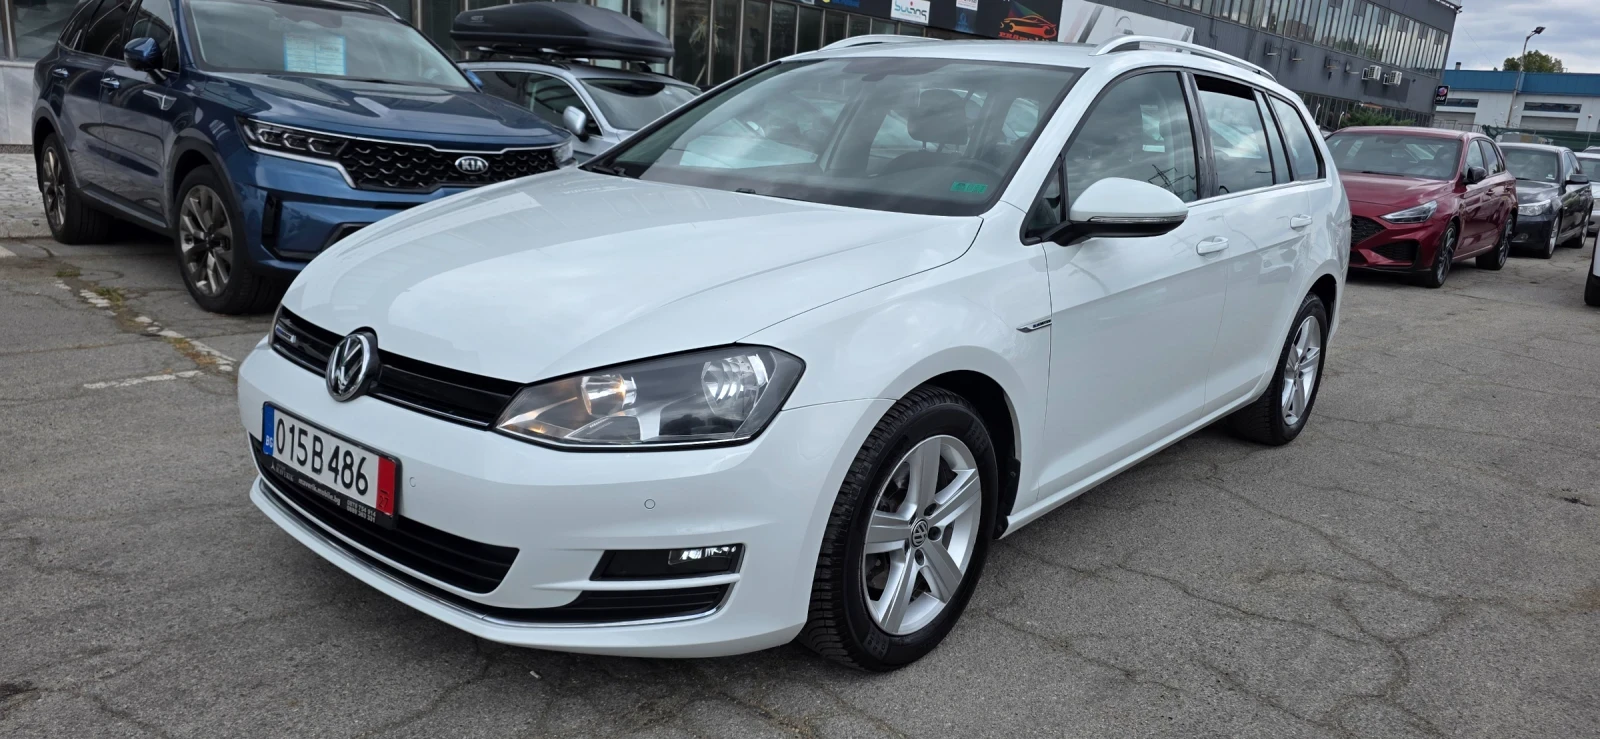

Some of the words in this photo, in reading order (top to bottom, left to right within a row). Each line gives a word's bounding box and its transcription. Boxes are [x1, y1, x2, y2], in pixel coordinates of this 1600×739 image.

[461, 159, 485, 171] KIA
[265, 434, 274, 448] BG
[275, 417, 369, 496] 015B486
